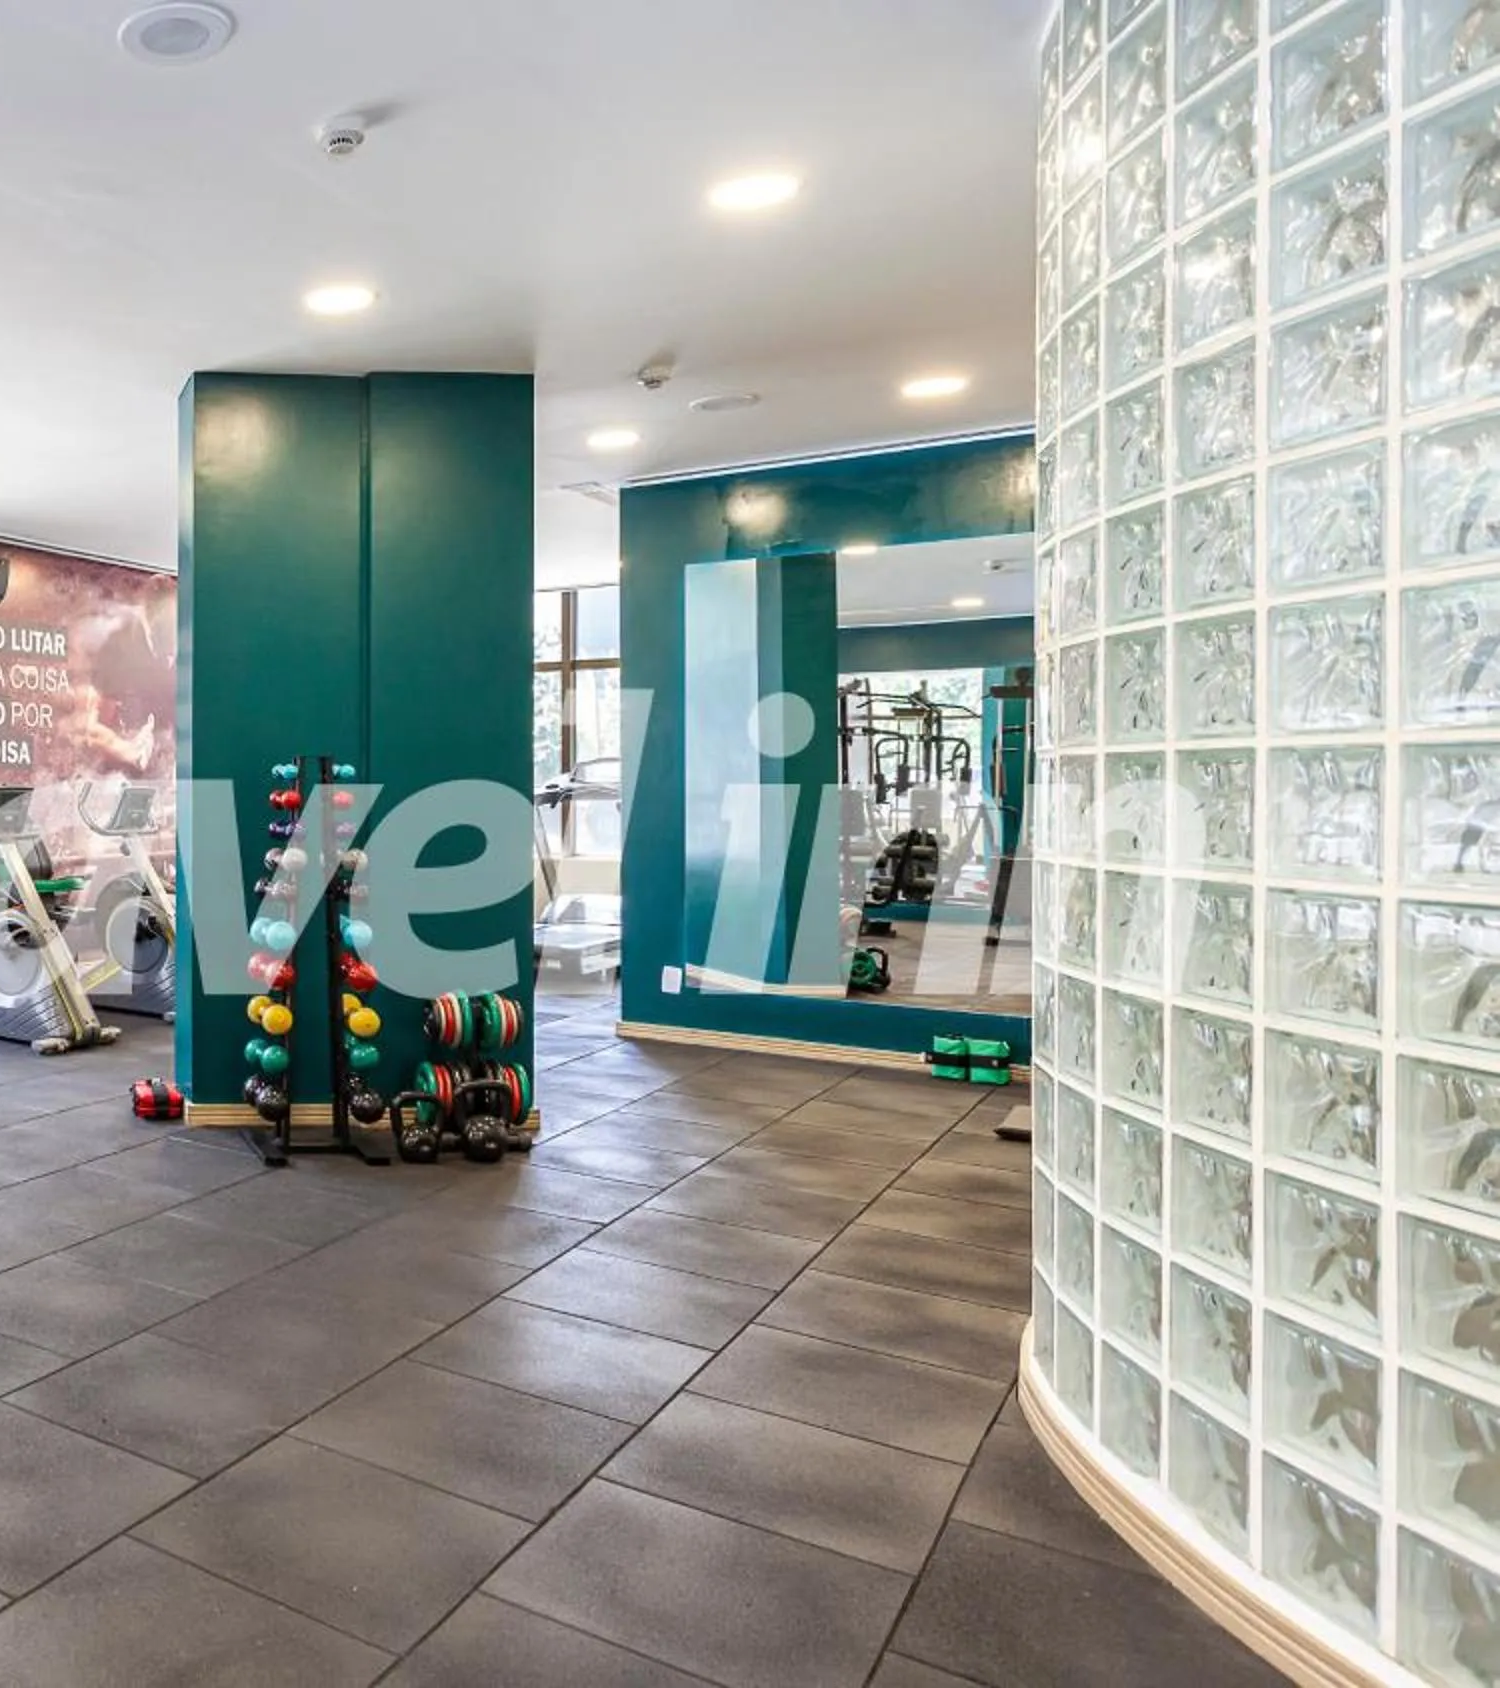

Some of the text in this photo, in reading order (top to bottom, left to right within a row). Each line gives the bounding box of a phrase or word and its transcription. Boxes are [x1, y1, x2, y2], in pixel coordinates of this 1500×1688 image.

[11, 628, 65, 656] LUTAR
[10, 663, 69, 693] COISA
[11, 701, 53, 729] POR
